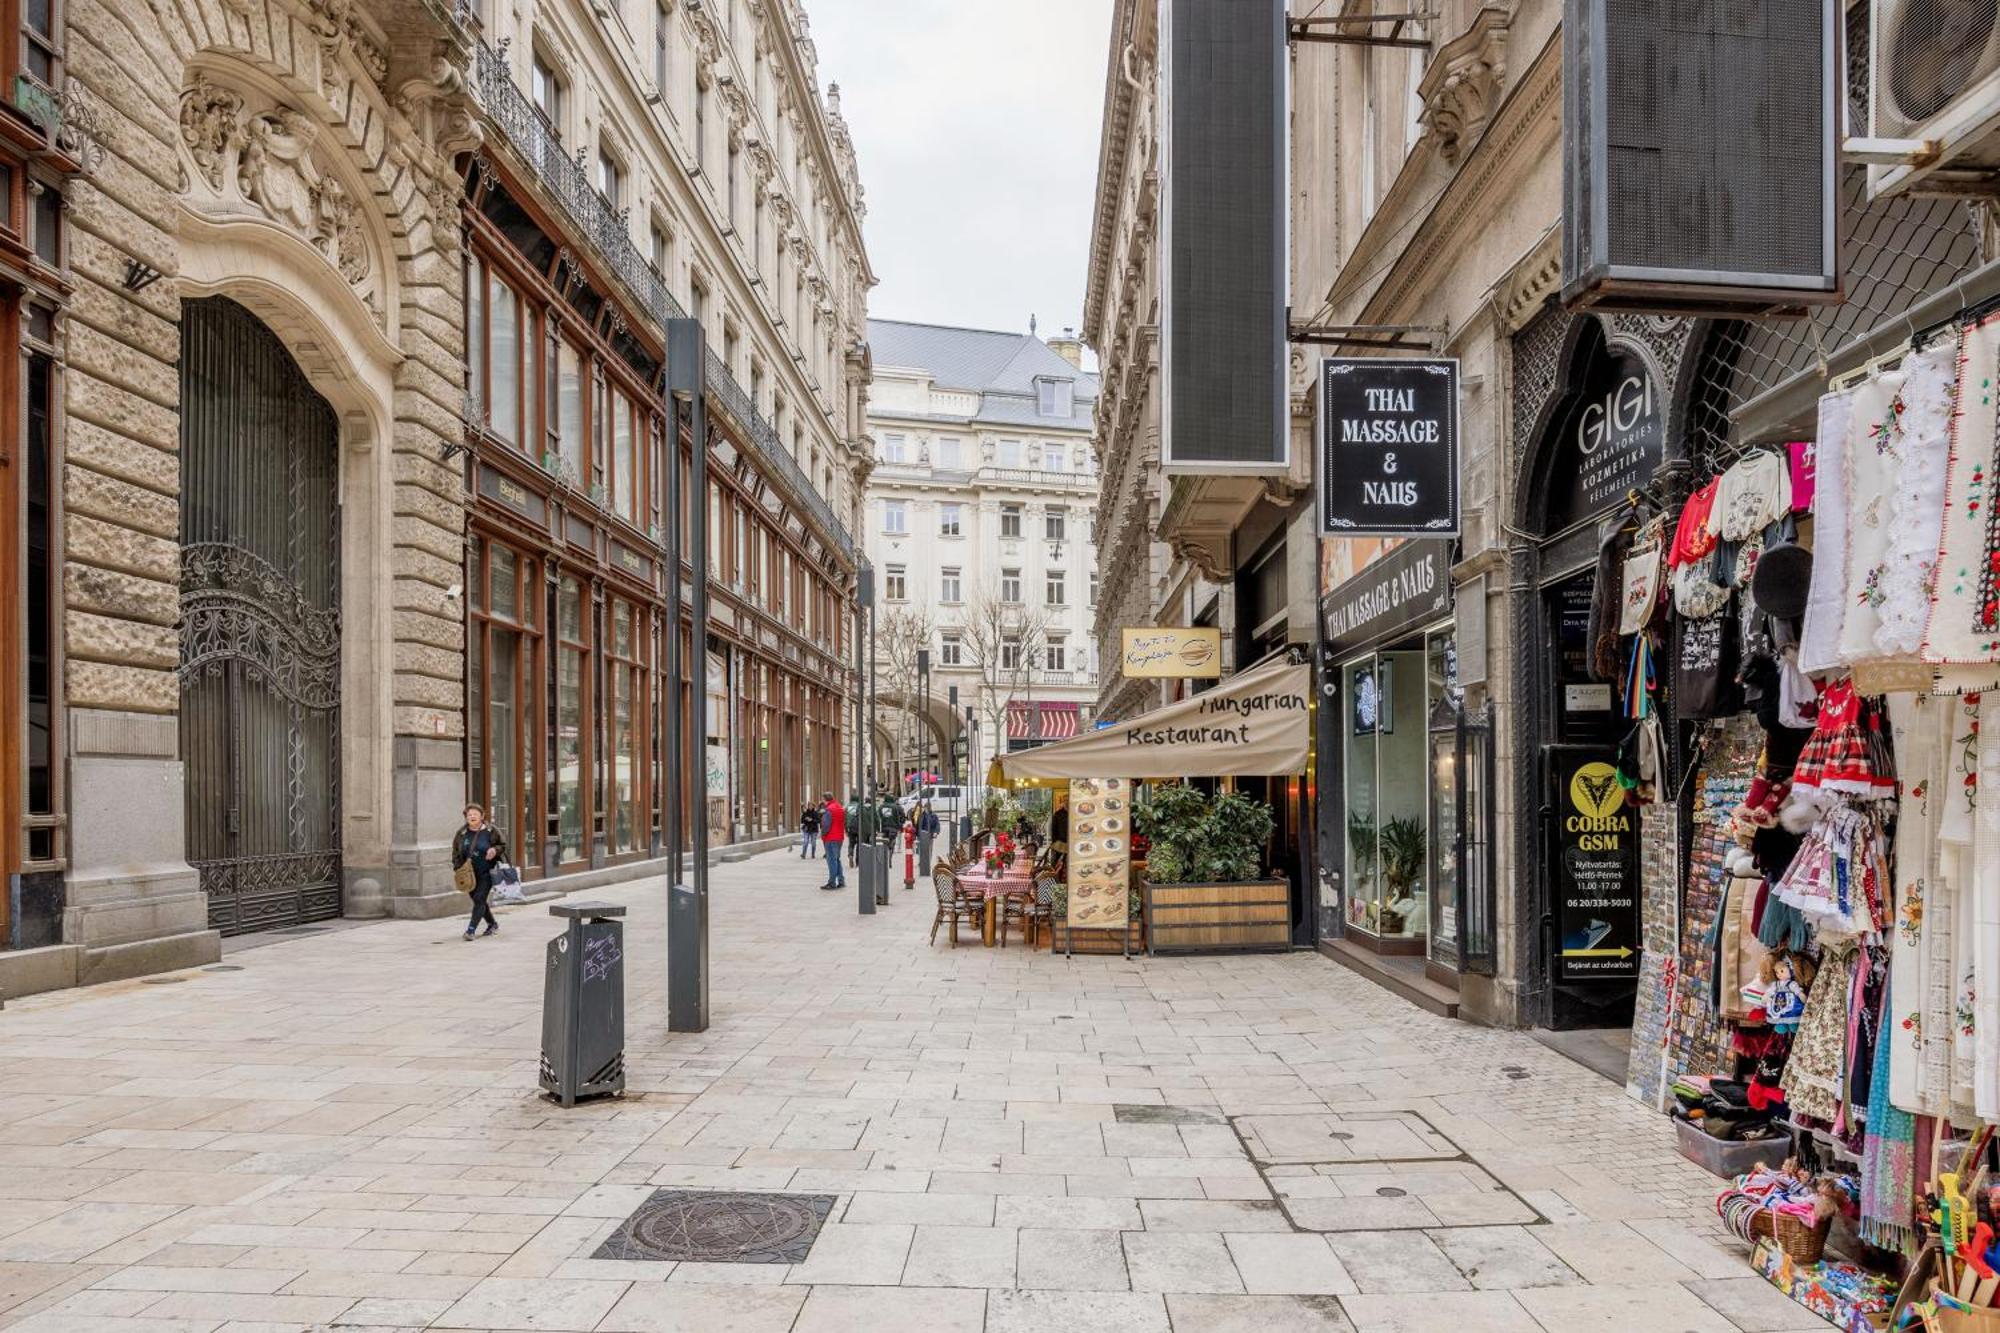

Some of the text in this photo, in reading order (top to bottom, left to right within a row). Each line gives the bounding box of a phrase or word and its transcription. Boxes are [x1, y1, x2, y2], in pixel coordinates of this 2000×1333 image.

[1365, 388, 1415, 412] THAI
[1578, 372, 1651, 454] GIGI
[1341, 419, 1439, 443] MASSAGE
[1579, 423, 1652, 474] LABORATORIES
[1383, 452, 1397, 474] &
[1582, 445, 1645, 491] KOZMETIKA
[1362, 481, 1418, 506] NAILS
[1327, 554, 1434, 640] THAI MASSAGE & NAILS
[1127, 724, 1249, 745] Restaurant
[1566, 815, 1630, 832] COBRA
[1578, 834, 1619, 851] GSM
[1567, 899, 1578, 907] 06
